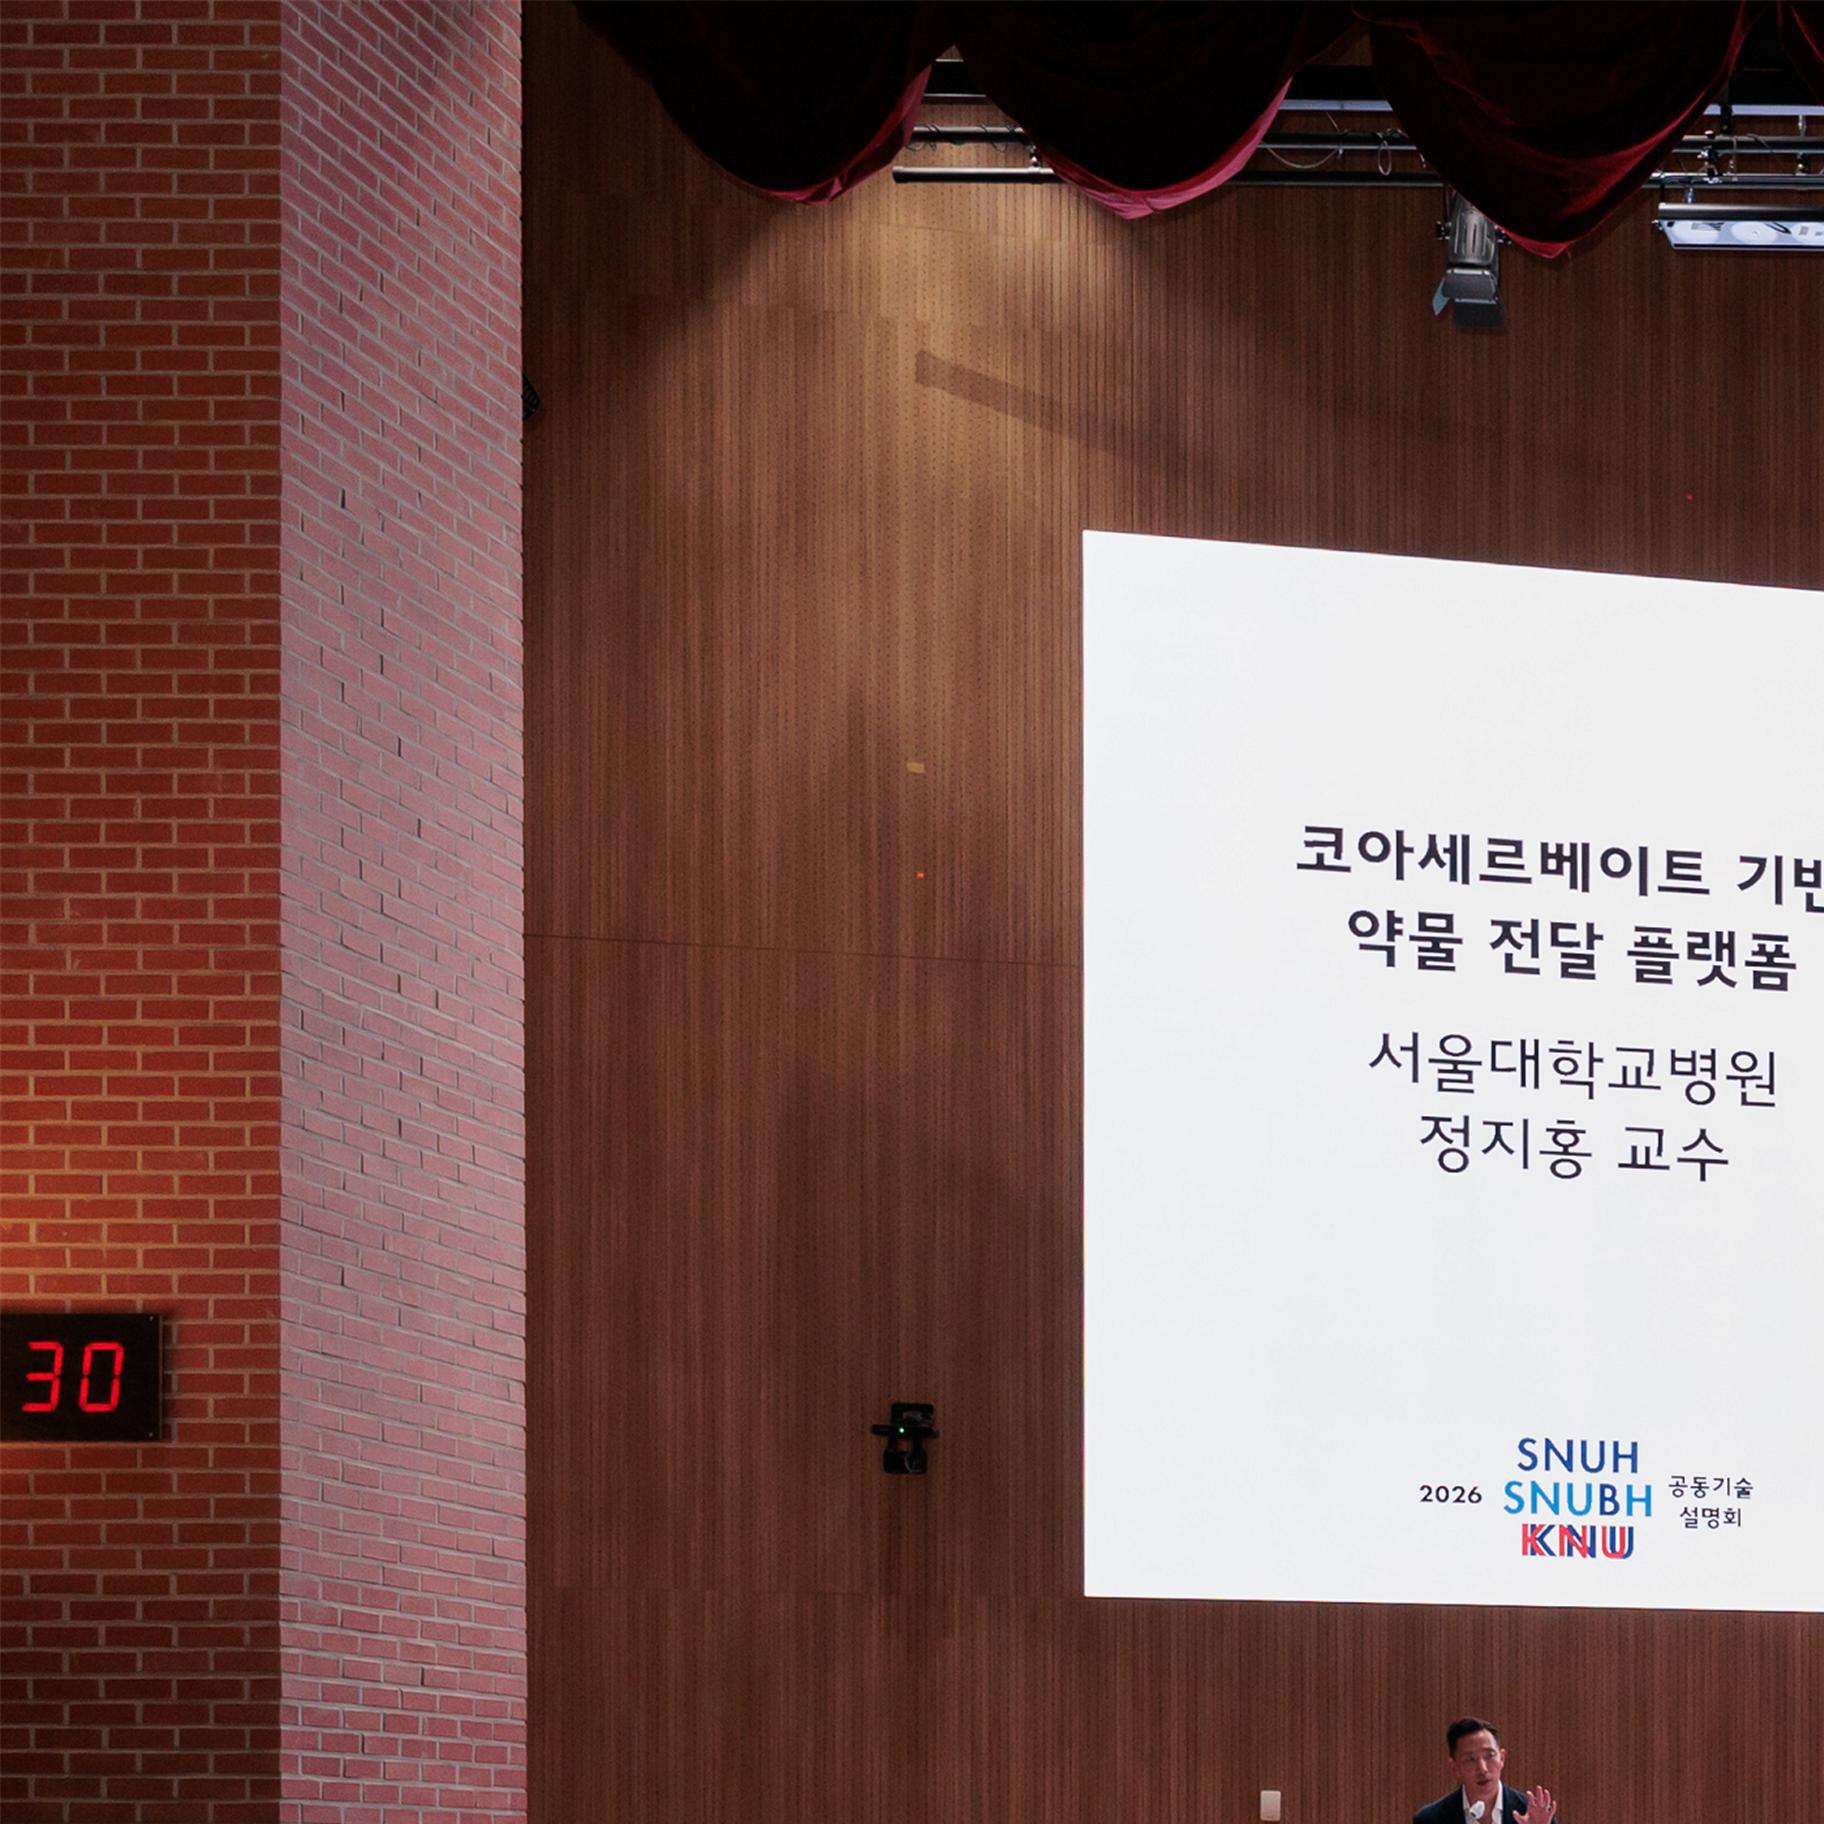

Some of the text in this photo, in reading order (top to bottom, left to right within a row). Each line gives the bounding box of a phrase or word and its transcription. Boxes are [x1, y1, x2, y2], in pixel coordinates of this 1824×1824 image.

[1295, 824, 1711, 898] 코아세르베이트
[1347, 909, 1798, 993] 약물 전달 플랫폼
[1368, 1031, 1776, 1108] 서울대학교병원
[1419, 1114, 1730, 1183] 정지홍 교수
[21, 1340, 126, 1414] 30
[1516, 1436, 1639, 1475] SNUH
[1418, 1484, 1483, 1505] 2026
[1503, 1479, 1653, 1518] SNUBH
[1667, 1475, 1754, 1500] 공동기술
[1679, 1506, 1742, 1530] 설명회
